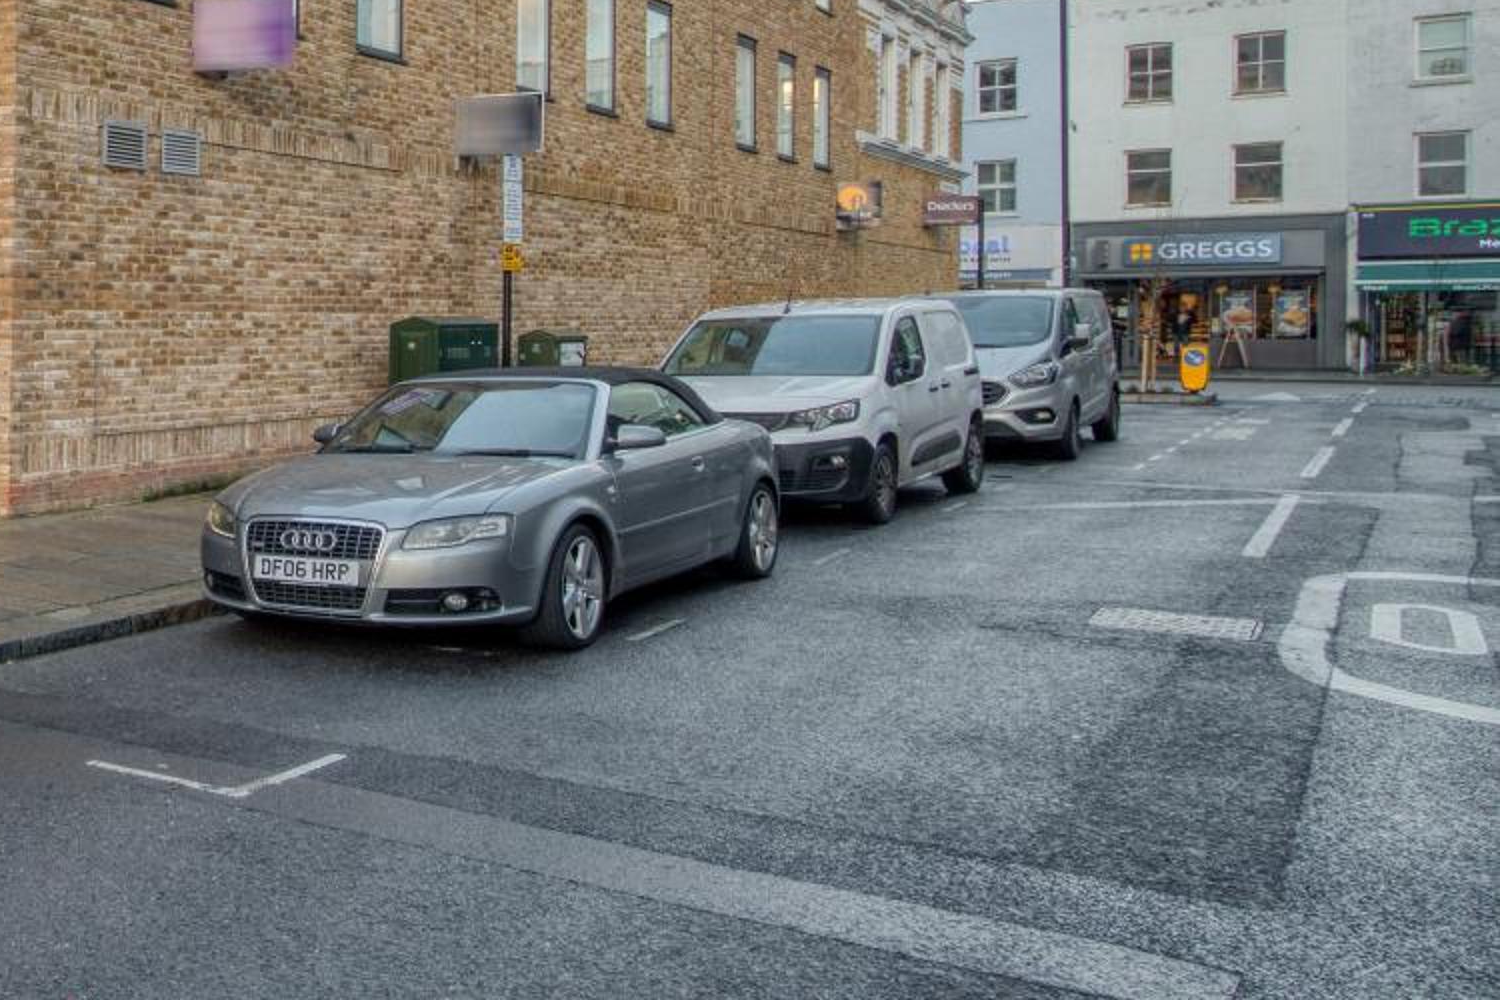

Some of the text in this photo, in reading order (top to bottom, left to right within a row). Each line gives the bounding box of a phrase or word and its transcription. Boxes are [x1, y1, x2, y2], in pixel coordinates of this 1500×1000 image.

[1157, 239, 1273, 260] GREGGS
[261, 557, 350, 580] DF06 HRP
